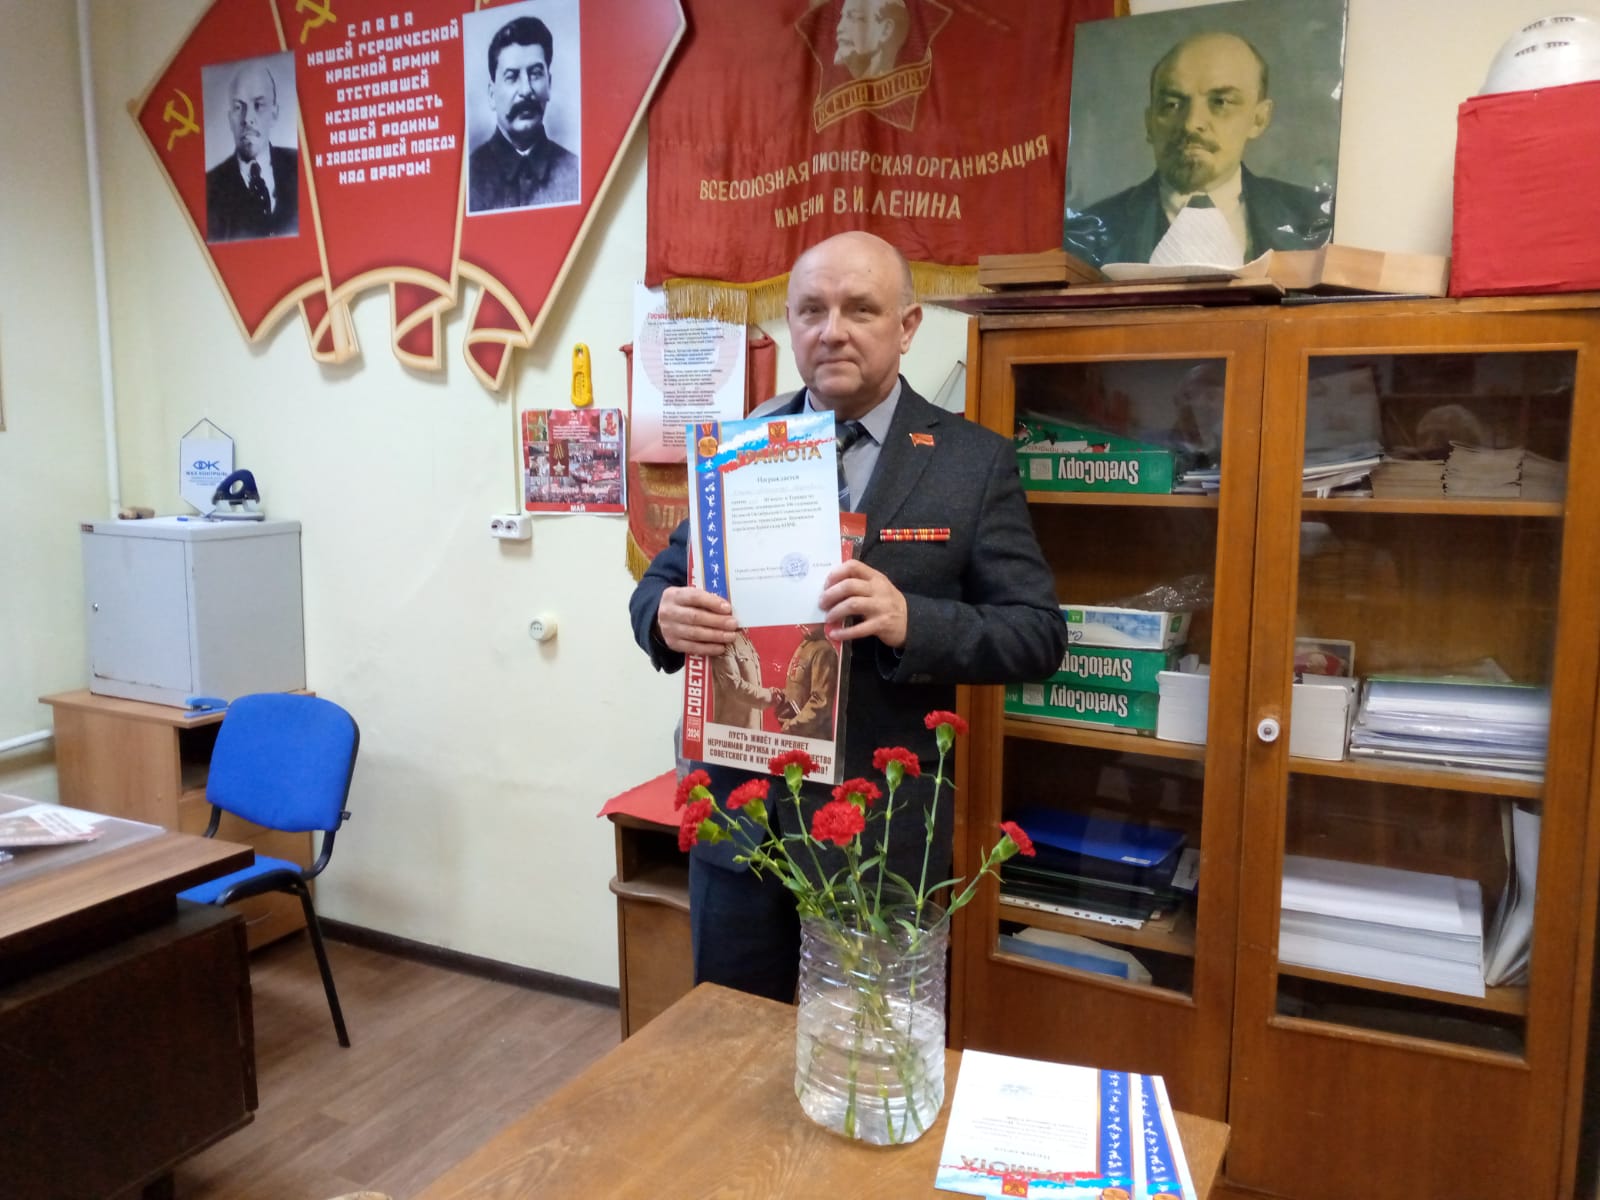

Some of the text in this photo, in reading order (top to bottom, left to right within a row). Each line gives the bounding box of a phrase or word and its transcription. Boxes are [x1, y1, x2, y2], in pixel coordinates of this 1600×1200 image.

[347, 11, 413, 37] СЛАВА
[307, 18, 459, 66] НАШЕЙ ГЕРОИЧЕСКОЙ
[326, 50, 440, 84] КРАСНОЙ АРМИИ
[337, 69, 429, 102] ОТСТОЯВШЕЙ
[325, 94, 443, 125] НЕЗАВИСИМОСТЬ
[330, 116, 439, 145] НАШЕЙ РОДИНЫ
[315, 135, 456, 167] И ЗАВОЕВАВШЕЙ ПОБЕДУ
[339, 158, 430, 184] НАД ВРАГОМ!
[700, 135, 1048, 201] ВСЕСОЮЗНАЯ ПИОНЕРСКАЯ ОРГАНИЗАЦИЯ
[775, 193, 824, 228] ИМЕНИ
[872, 190, 961, 220] ЛЕНИНА
[736, 444, 822, 467] ГРАМОТА
[1057, 456, 1139, 485] SvetoCopy
[1057, 652, 1132, 683] SvetoCop
[1049, 684, 1128, 718] SvetoCopy
[710, 748, 747, 762] СОВЕТСКОГО
[728, 730, 748, 741] ПУСТЬ
[751, 733, 772, 745] ЖИВЁТ
[781, 739, 809, 750] КРЕПНЕТ
[745, 744, 769, 754] ДРУЖБА
